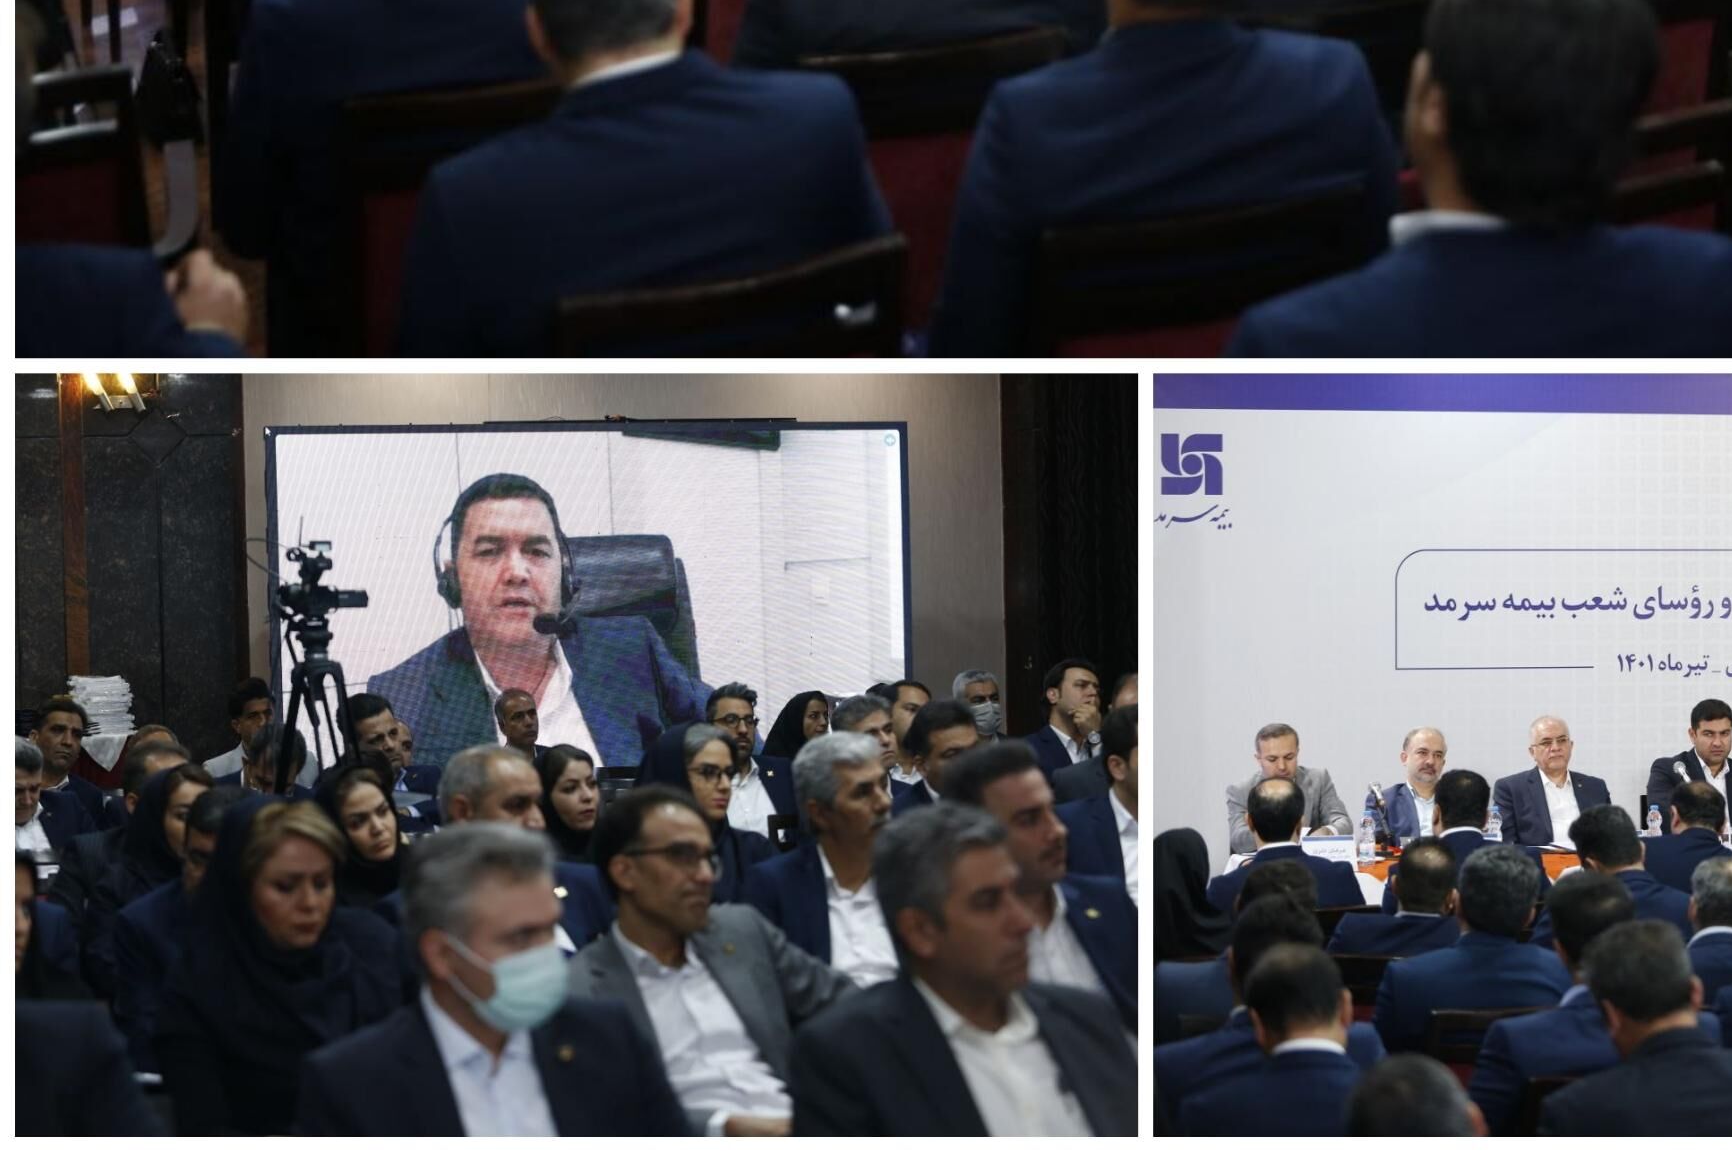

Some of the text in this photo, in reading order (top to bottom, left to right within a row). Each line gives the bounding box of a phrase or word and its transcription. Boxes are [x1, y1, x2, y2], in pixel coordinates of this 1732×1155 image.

[1209, 508, 1233, 531] بیمه
[1423, 593, 1497, 621] سرمد
[1502, 593, 1557, 619] بیمه
[1561, 586, 1628, 619] شعب
[1632, 584, 1715, 620] رؤسای
[1719, 598, 1732, 620] و
